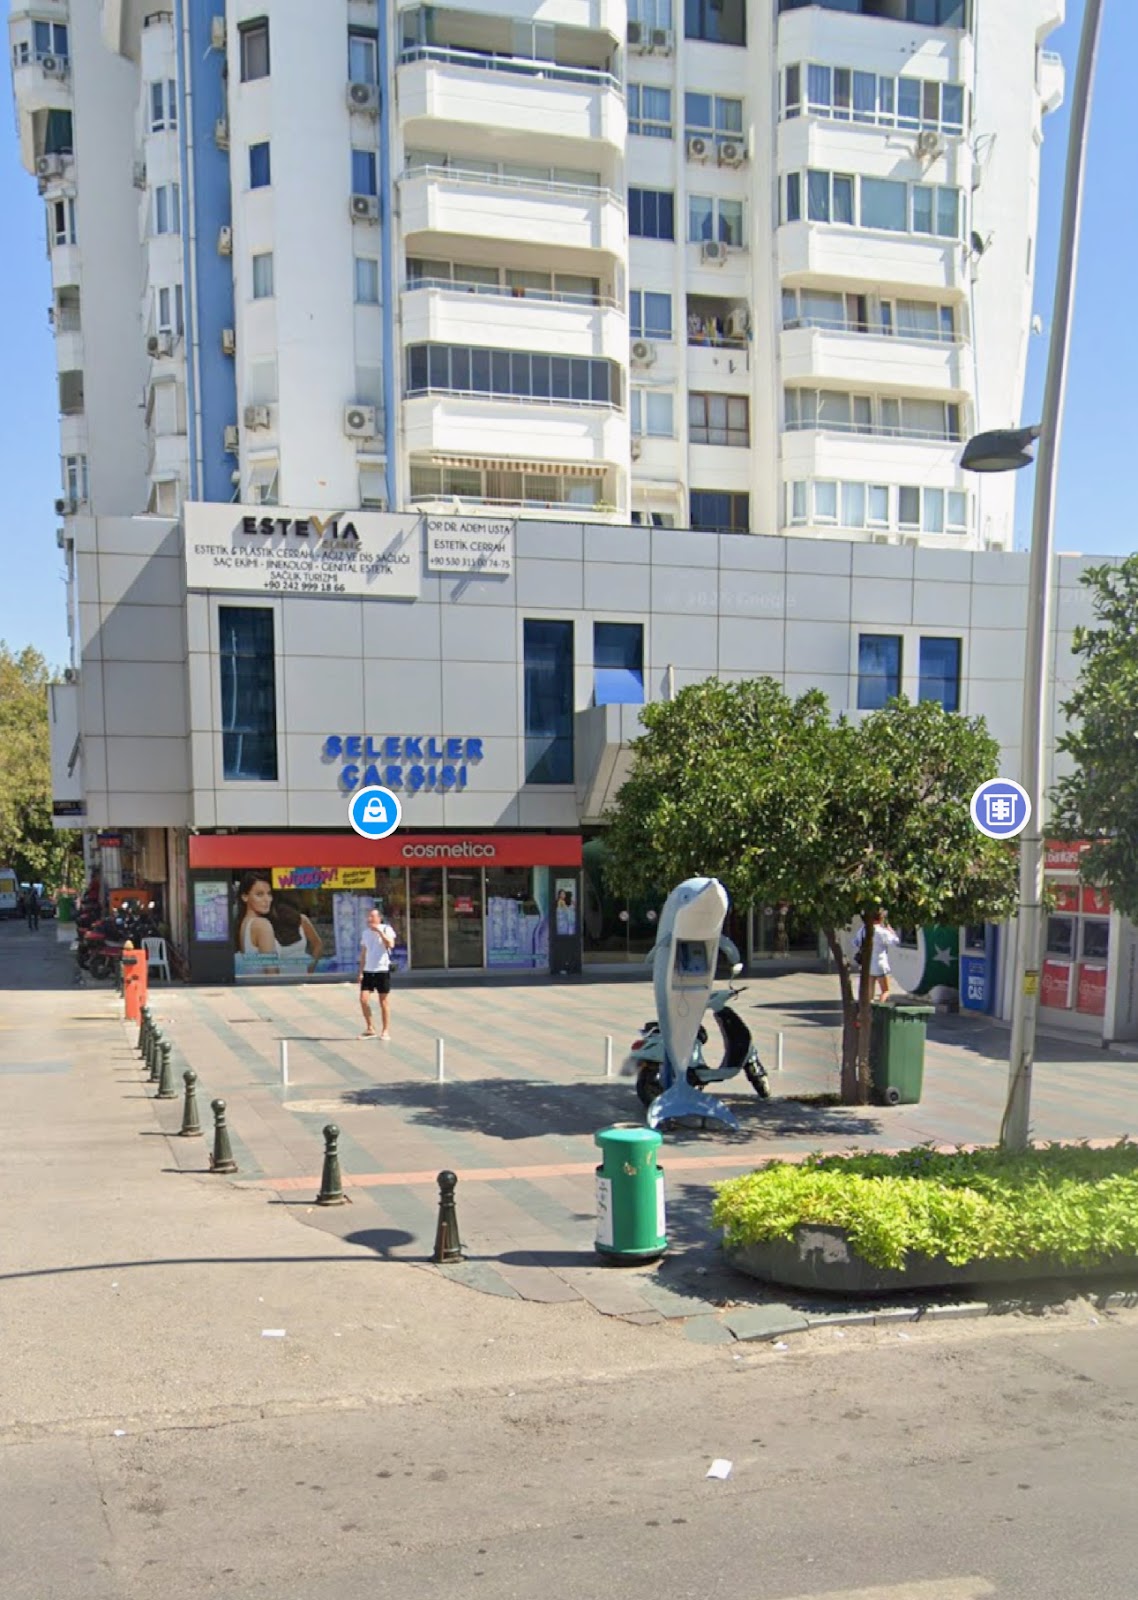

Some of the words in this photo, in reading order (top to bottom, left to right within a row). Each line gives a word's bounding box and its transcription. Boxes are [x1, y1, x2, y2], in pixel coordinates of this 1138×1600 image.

[242, 512, 359, 540] ESTEVIA
[460, 523, 486, 533] ADEM
[488, 524, 510, 534] USTA
[470, 542, 505, 552] CERRAH
[345, 551, 357, 561] VE
[430, 557, 444, 565] +90
[213, 557, 232, 568] SAÇ
[263, 580, 280, 589] +90
[283, 581, 299, 590] 242
[301, 582, 318, 591] 999
[321, 583, 332, 592] 18
[334, 583, 345, 592] 66
[326, 735, 484, 760] SELEKLER
[341, 764, 468, 790] ÇARŞISI
[402, 841, 496, 858] cosmetica
